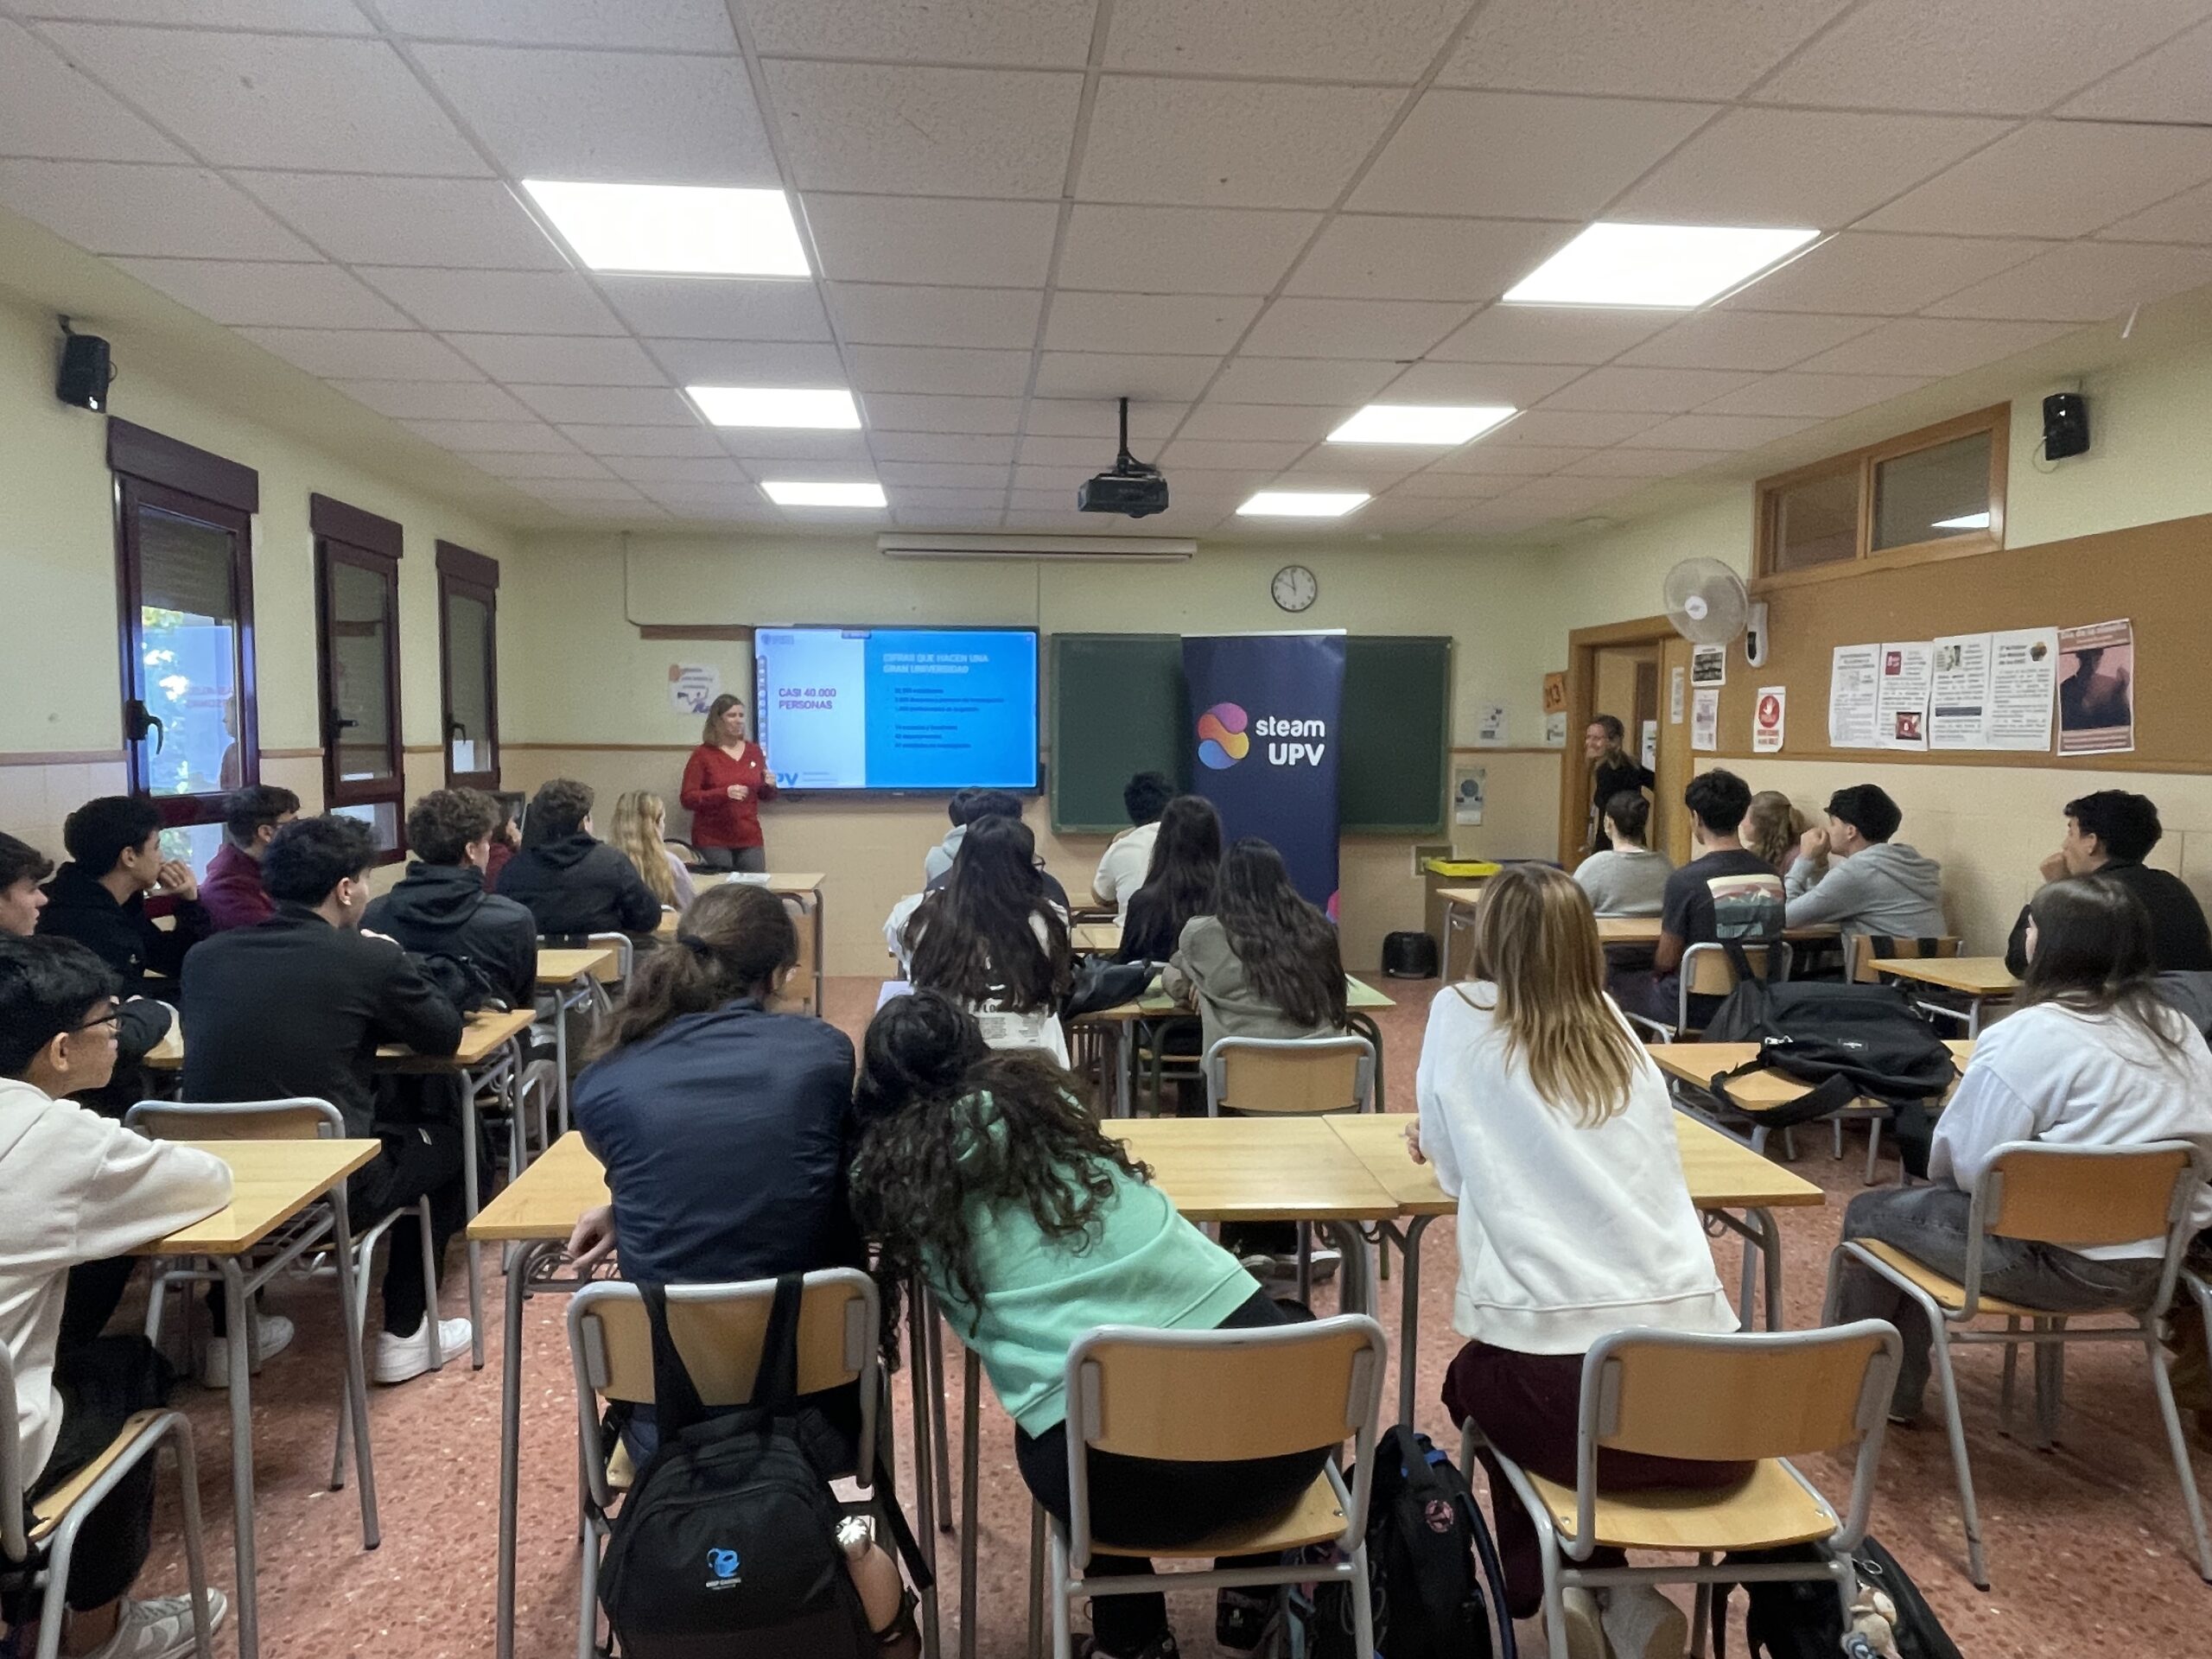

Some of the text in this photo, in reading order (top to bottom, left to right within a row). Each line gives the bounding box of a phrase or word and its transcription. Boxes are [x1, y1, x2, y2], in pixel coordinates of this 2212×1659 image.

[779, 688, 836, 697] CASI 40.000
[779, 700, 833, 709] PERSONAS
[1255, 715, 1325, 737] steam
[1268, 742, 1325, 766] UPV
